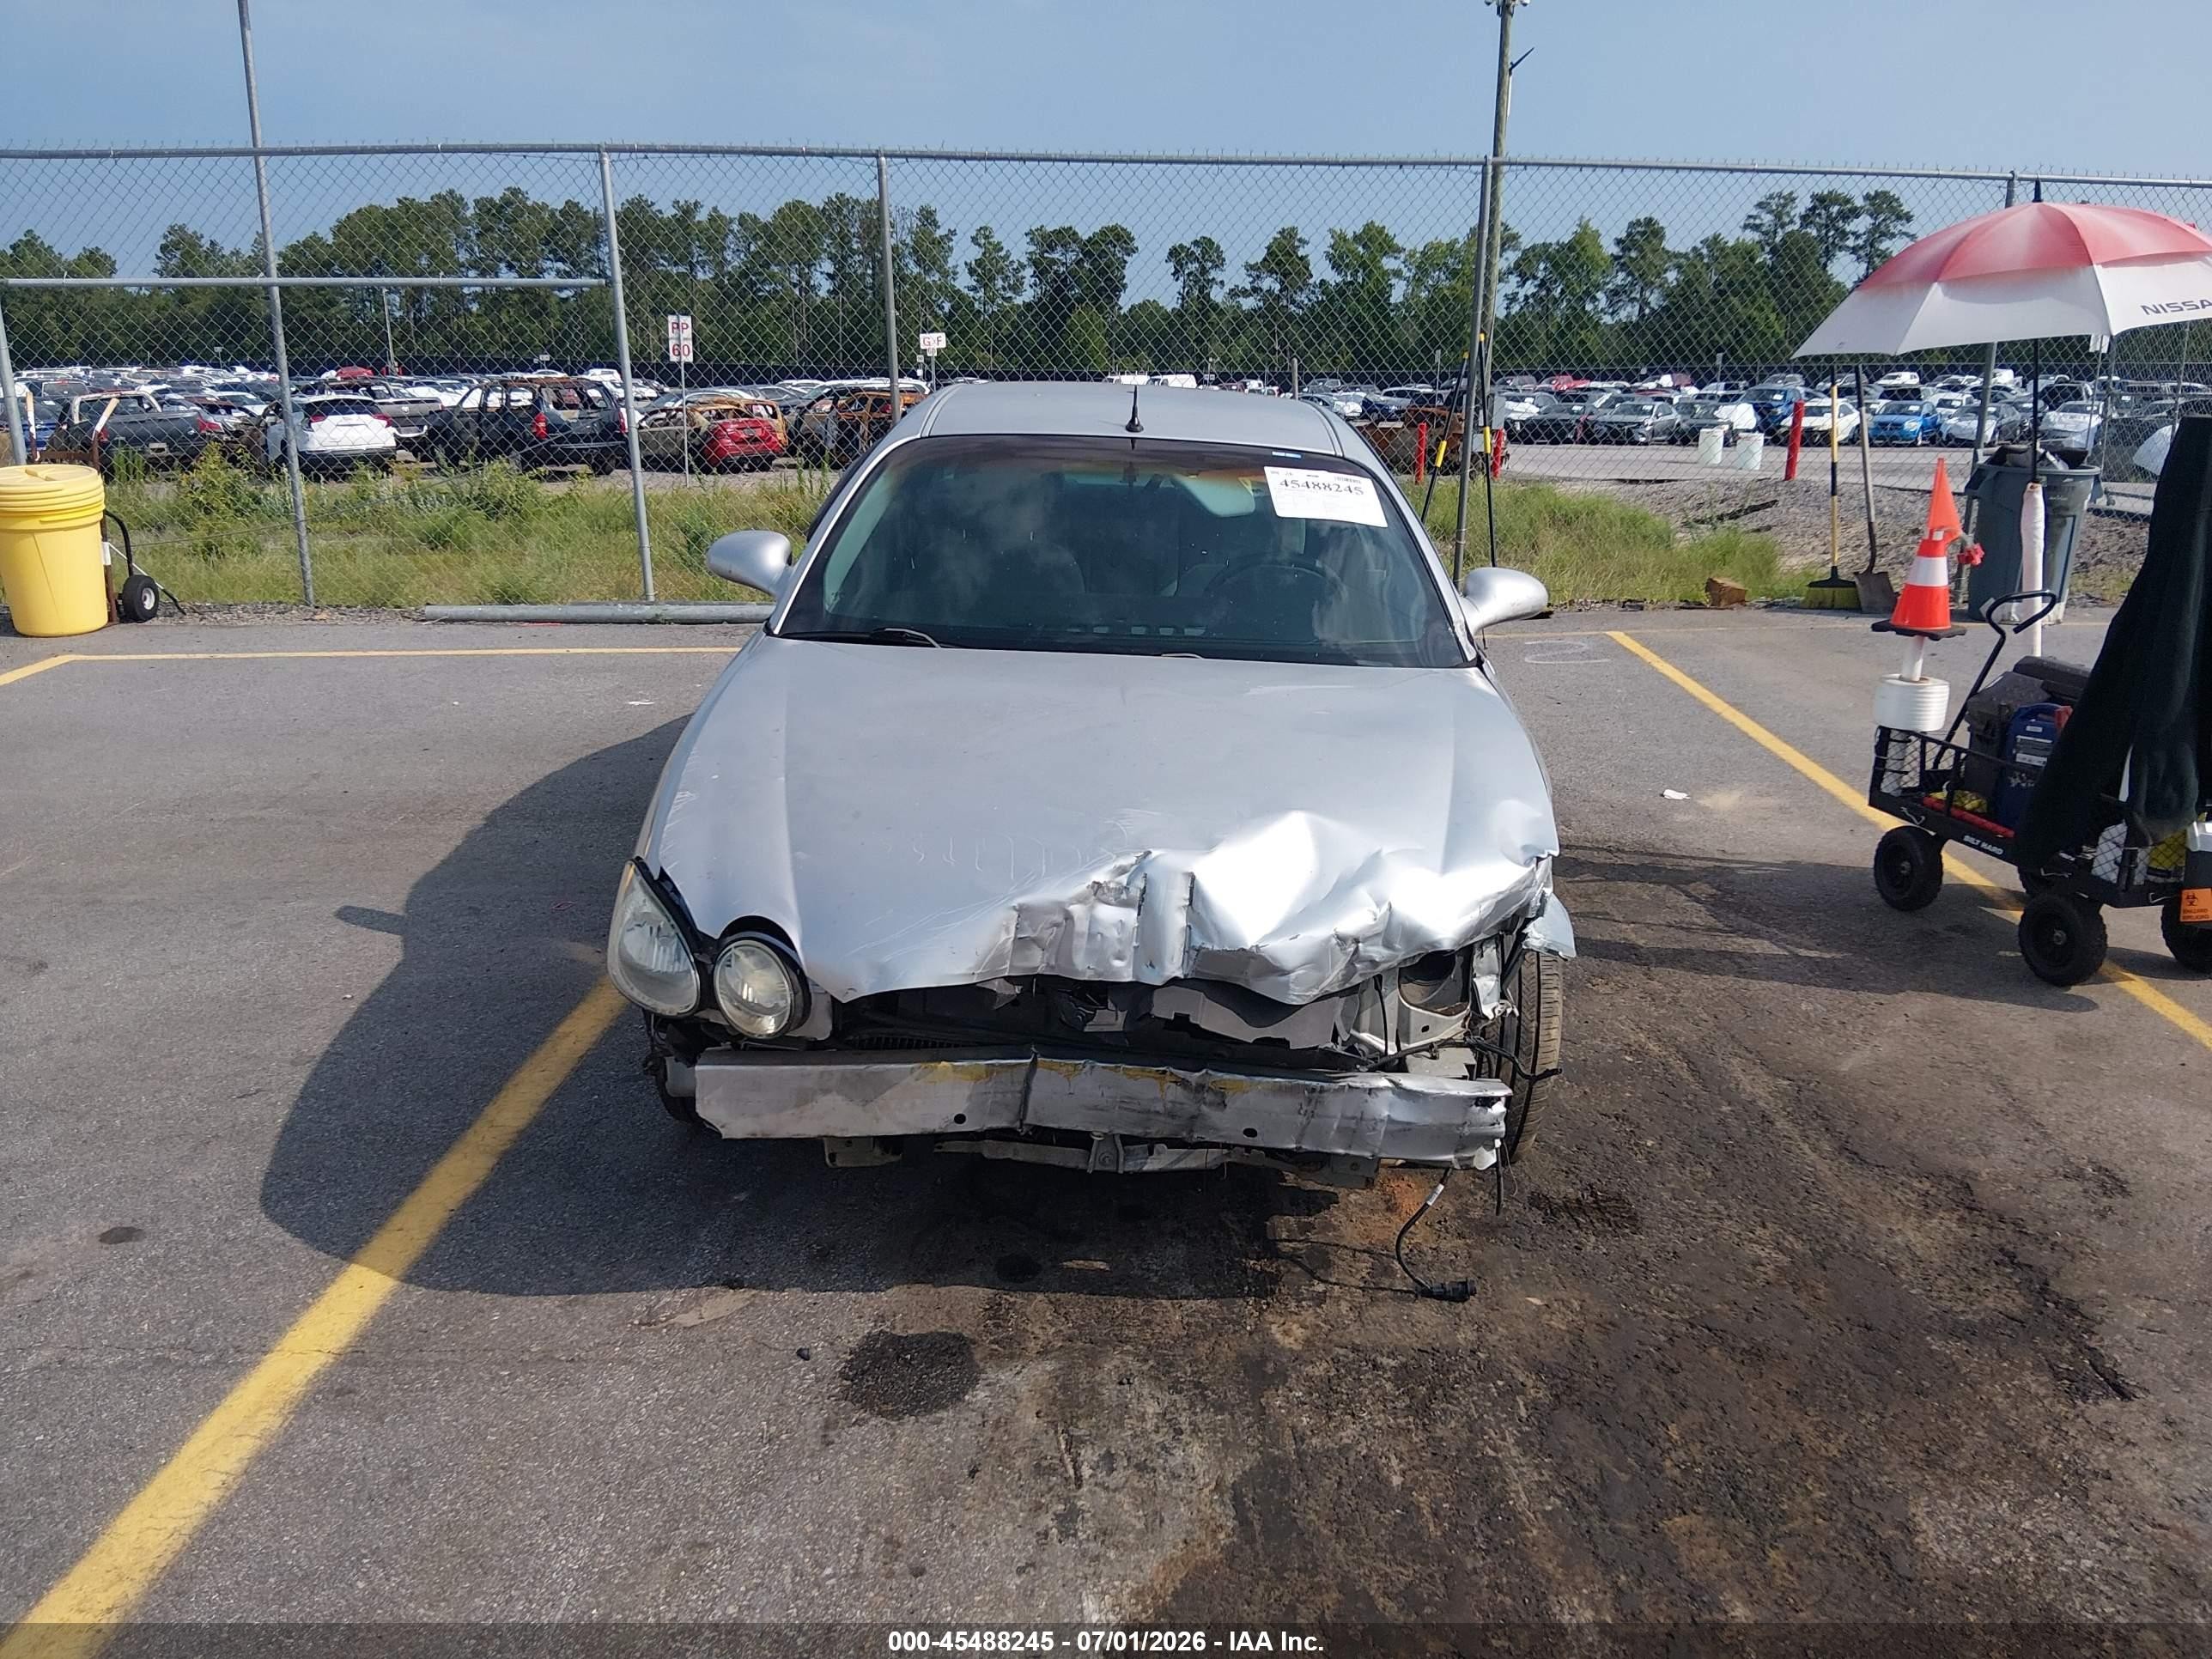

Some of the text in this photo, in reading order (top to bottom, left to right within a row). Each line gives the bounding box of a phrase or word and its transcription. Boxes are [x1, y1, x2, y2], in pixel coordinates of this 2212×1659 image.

[672, 322, 689, 334] PP
[672, 343, 690, 357] 60
[1279, 478, 1364, 495] 45488245
